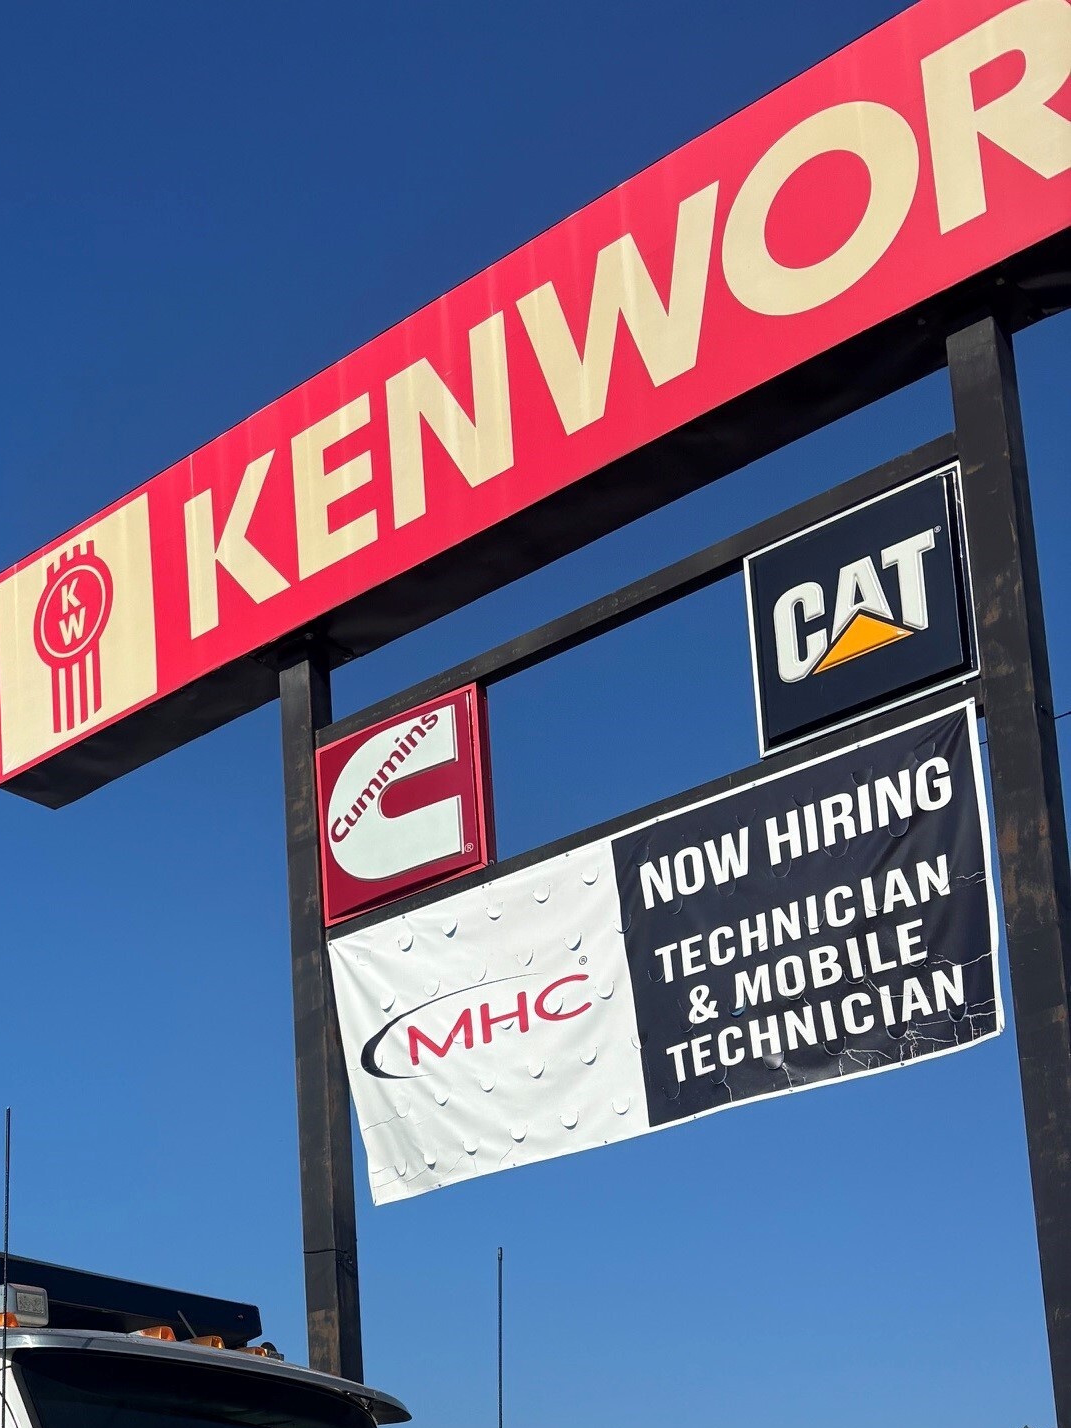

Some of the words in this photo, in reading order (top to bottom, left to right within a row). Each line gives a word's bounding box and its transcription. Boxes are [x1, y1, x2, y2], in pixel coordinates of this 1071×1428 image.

[773, 528, 936, 684] CAT
[330, 712, 440, 843] Cummins
[639, 826, 750, 910] NOW
[765, 756, 954, 867] HIRING
[654, 853, 951, 984] TECHNICIAN
[688, 984, 719, 1025] &
[734, 918, 929, 1010] MOBILE
[407, 973, 593, 1066] MHC
[665, 963, 965, 1084] TECHNICIAN
